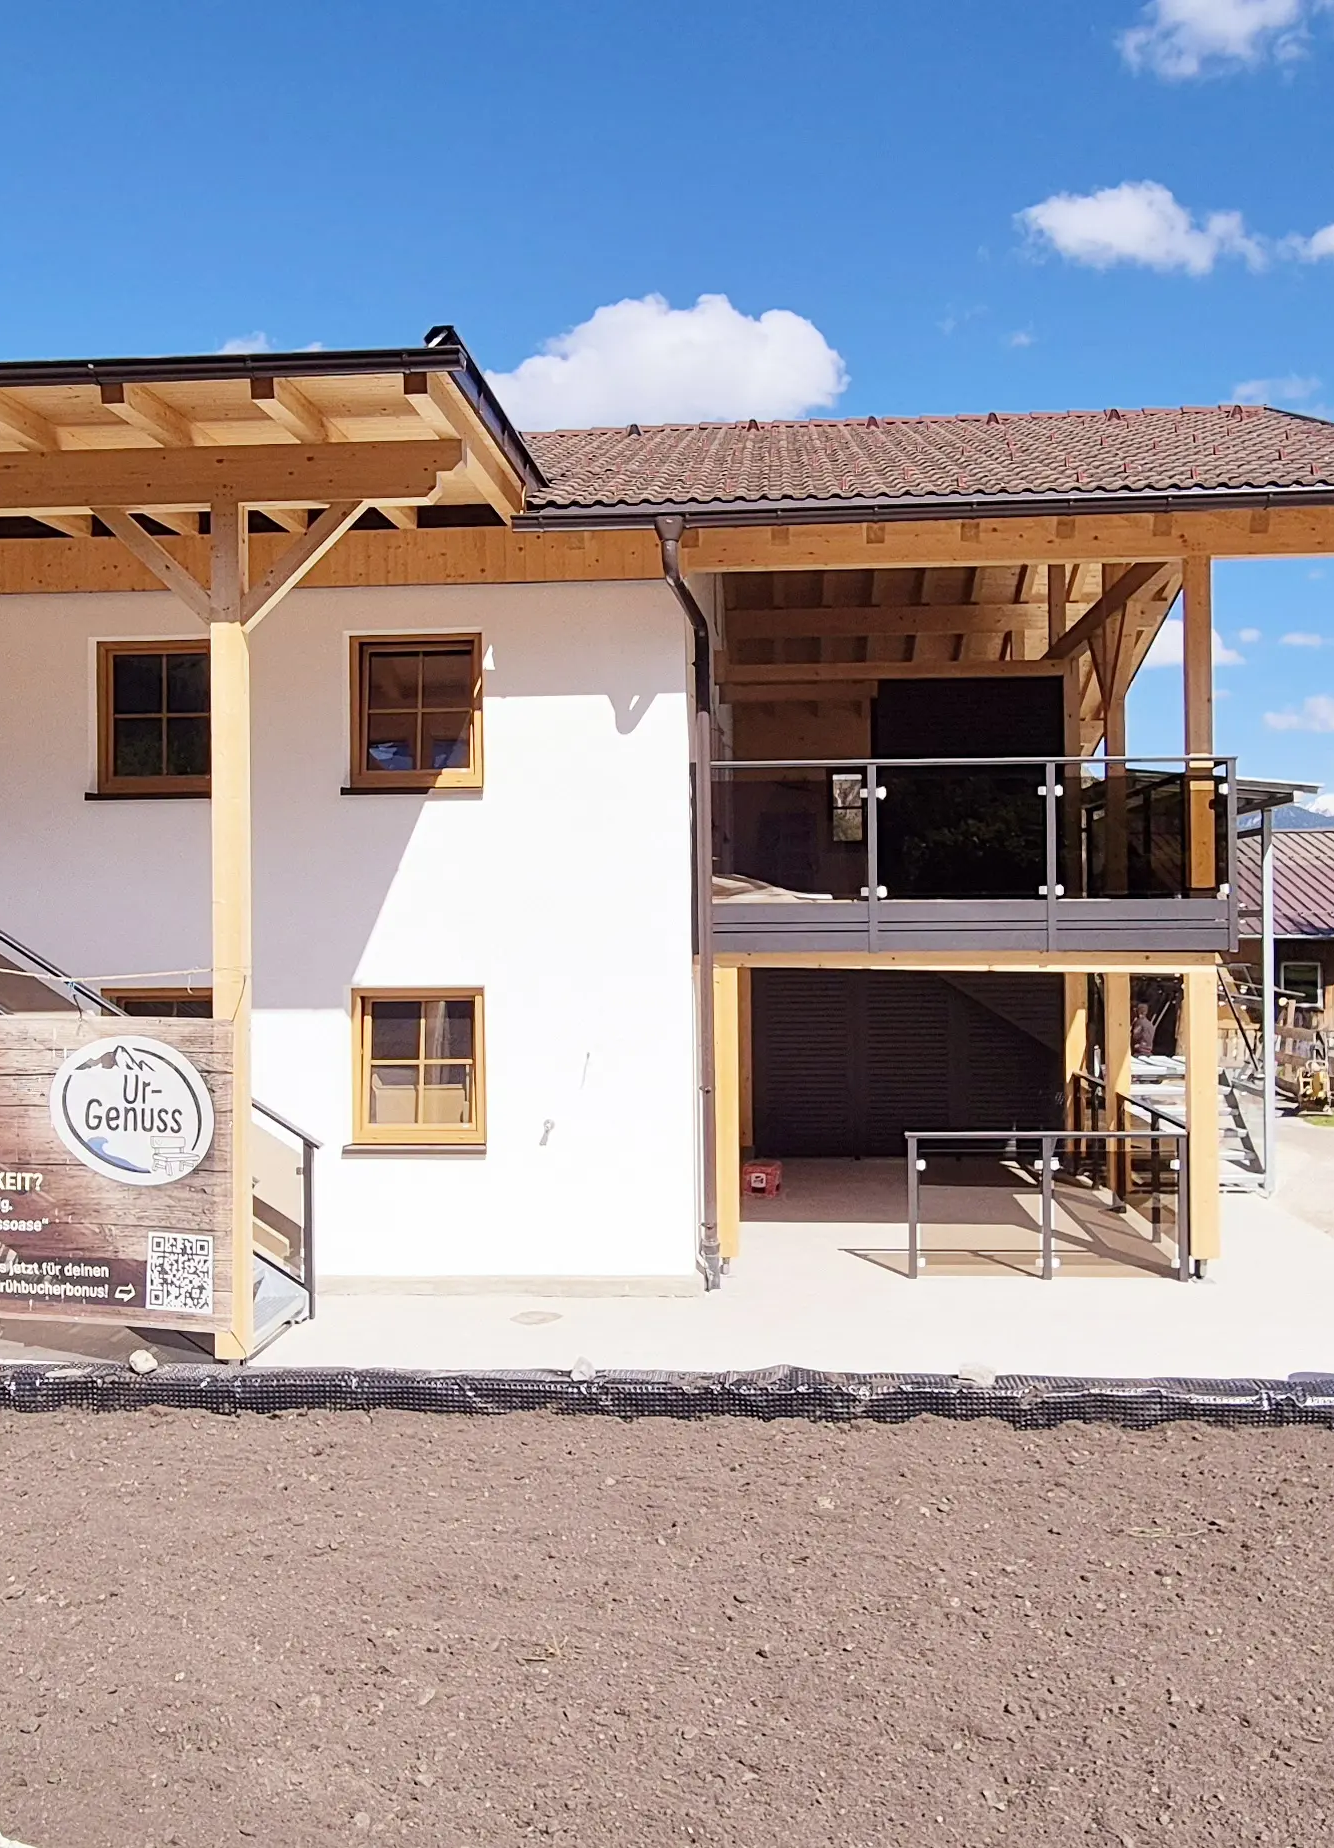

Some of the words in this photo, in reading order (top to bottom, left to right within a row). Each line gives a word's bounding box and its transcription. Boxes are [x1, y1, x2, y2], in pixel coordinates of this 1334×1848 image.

[123, 1074, 162, 1104] Ur-
[85, 1098, 183, 1133] Genuss
[9, 1261, 39, 1276] jetzt
[42, 1262, 61, 1275] für
[64, 1263, 110, 1277] deinen
